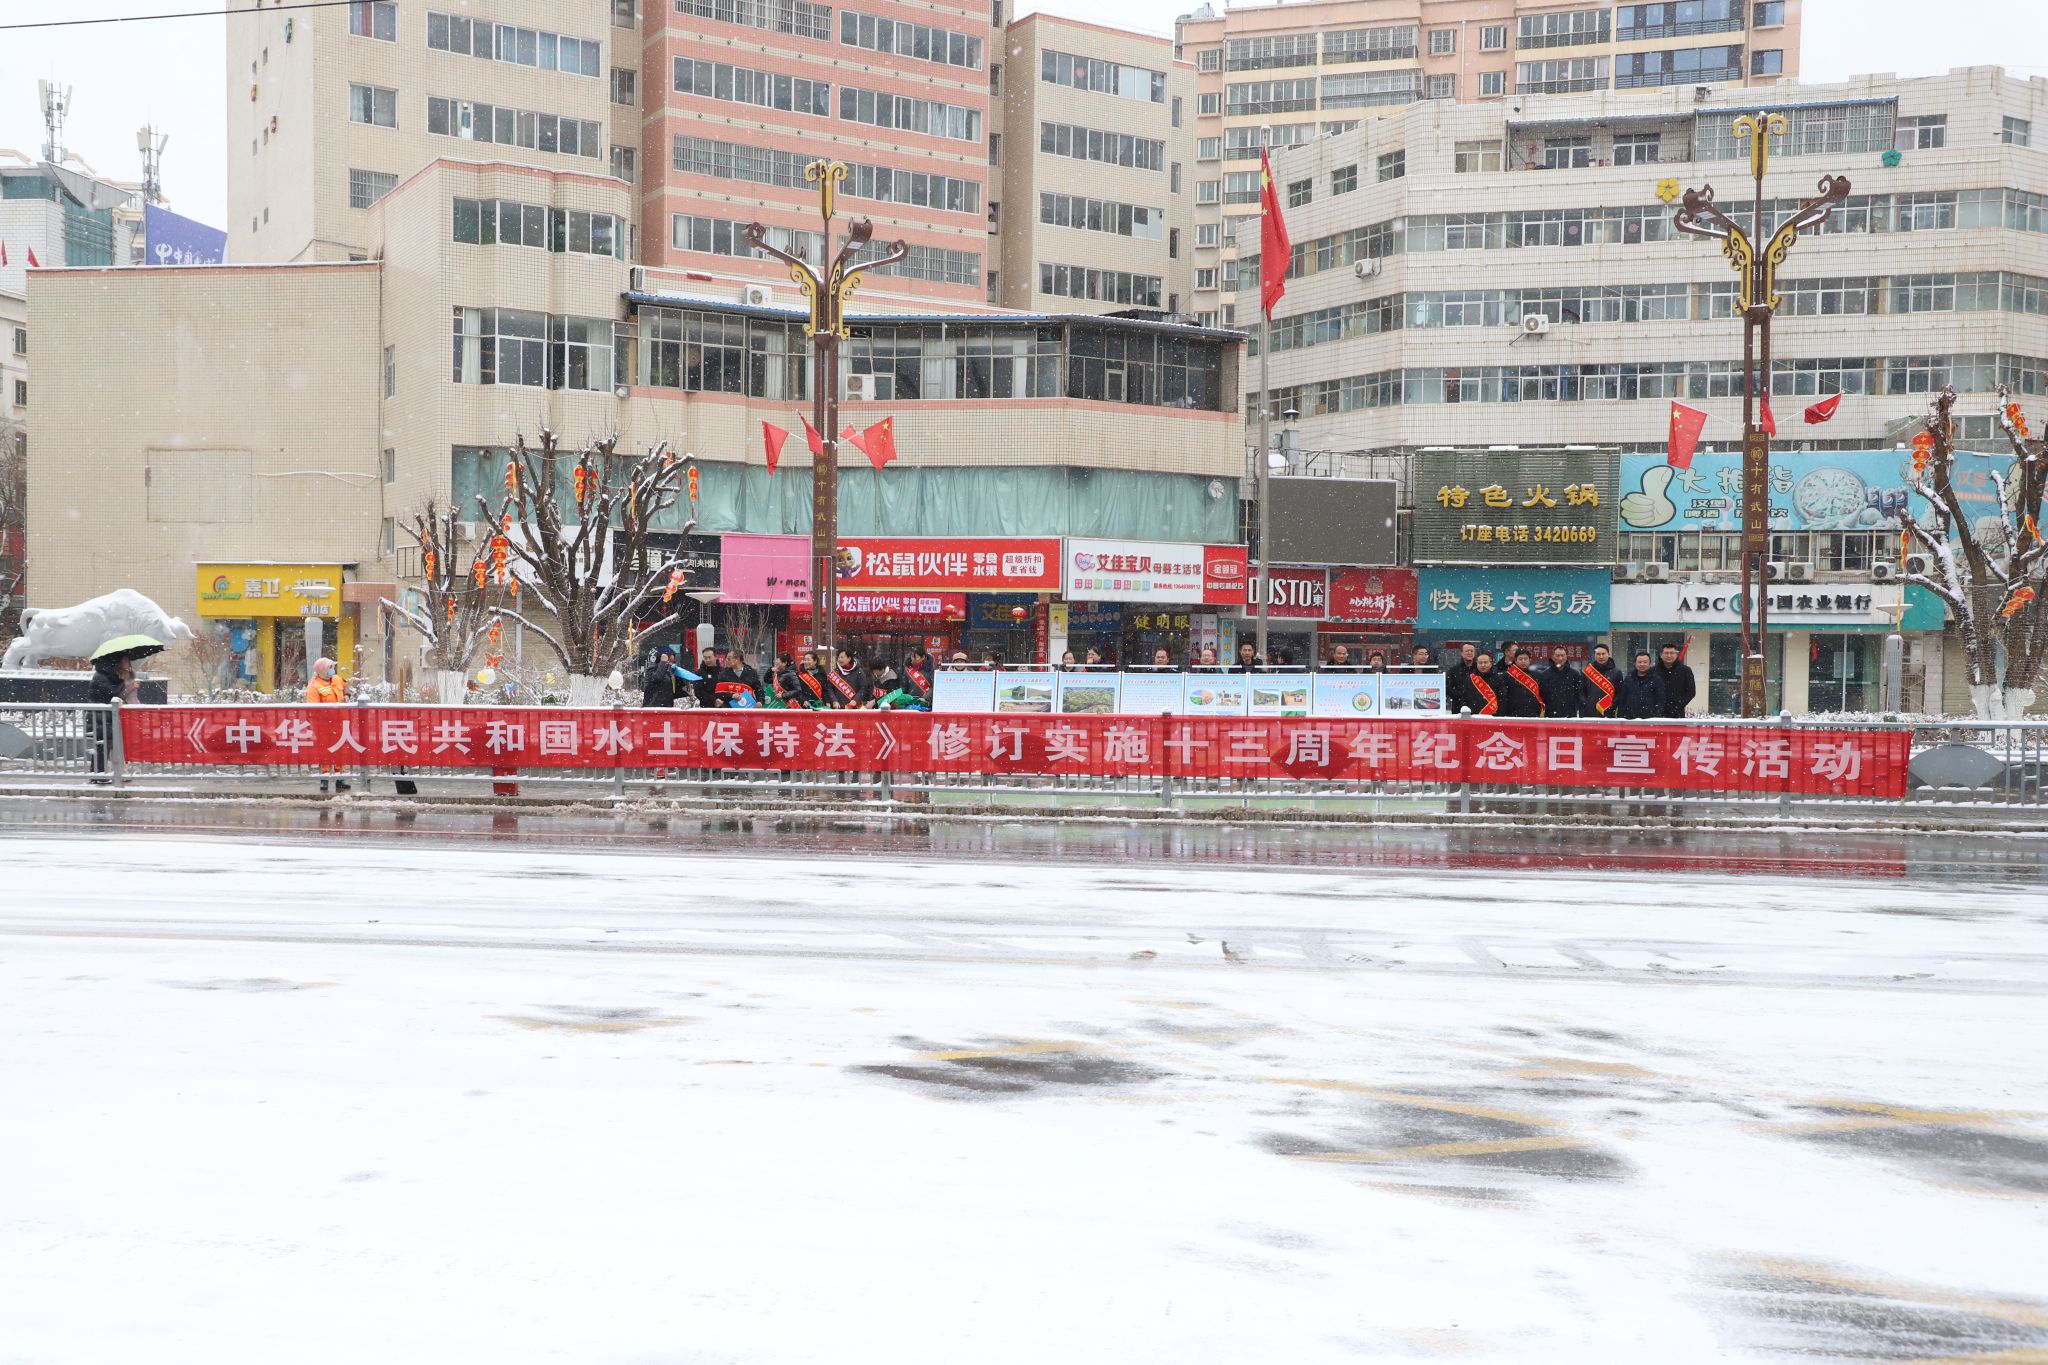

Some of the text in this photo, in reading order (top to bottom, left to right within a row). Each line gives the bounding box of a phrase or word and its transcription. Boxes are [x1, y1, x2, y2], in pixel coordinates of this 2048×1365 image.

[1437, 484, 1599, 509] 特色火锅
[1460, 525, 1597, 543] 订座电话 3420669
[866, 552, 968, 577] 松鼠伙伴
[973, 552, 998, 564] 零食
[1005, 555, 1042, 564] 超级折扣
[1096, 554, 1151, 573] 艾佳宝贝
[973, 565, 998, 577] 水果
[1009, 566, 1038, 574] 更省钱
[1153, 563, 1201, 575] 母婴生活馆
[842, 597, 900, 612] 松鼠伙伴
[1430, 589, 1597, 614] 快康大药房
[1678, 597, 1726, 611] ABC
[187, 717, 1862, 780] 《中华人民共和国水土保持法》修订实施十三周年纪念日宣传活动
